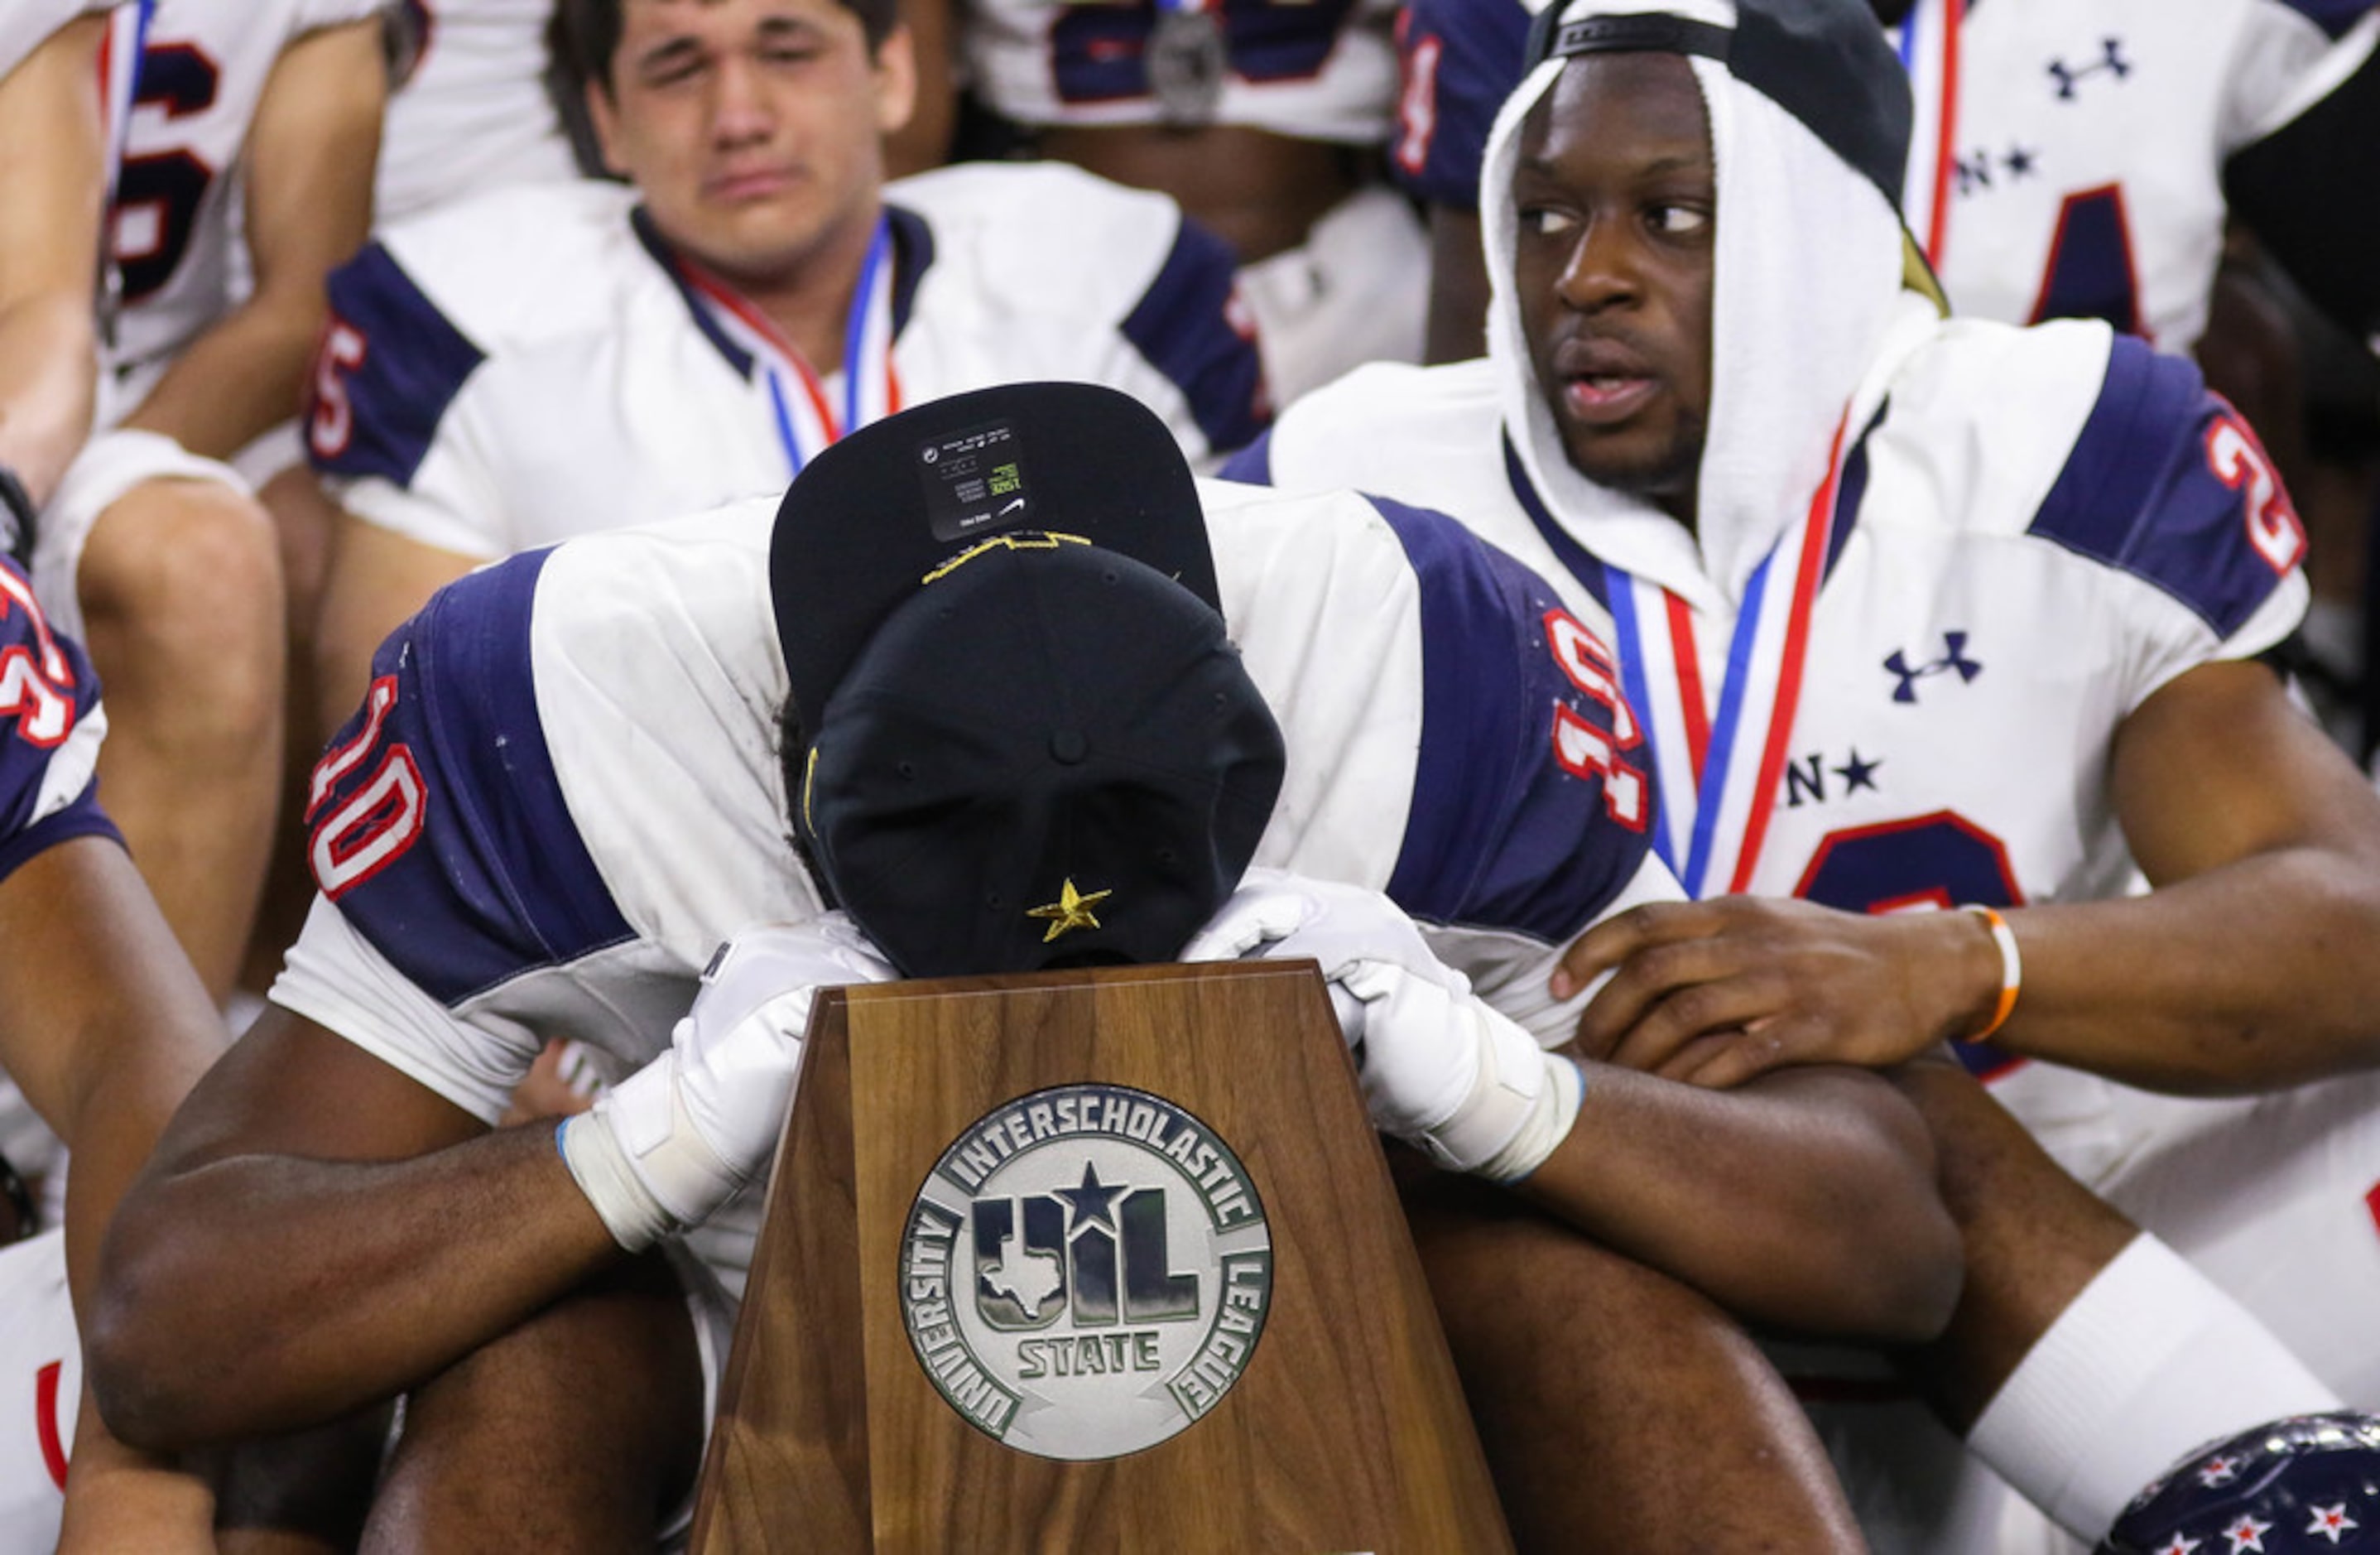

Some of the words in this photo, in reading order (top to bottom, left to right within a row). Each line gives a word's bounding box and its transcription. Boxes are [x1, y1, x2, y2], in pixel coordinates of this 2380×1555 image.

[303, 674, 428, 903] 10
[1542, 606, 1650, 835] 10
[949, 1094, 1253, 1227] INTERSCHOLASTIC
[909, 1209, 1015, 1432] UNIVERSITY
[1017, 1330, 1161, 1379] STATE
[1178, 1261, 1264, 1410] LEAGUE
